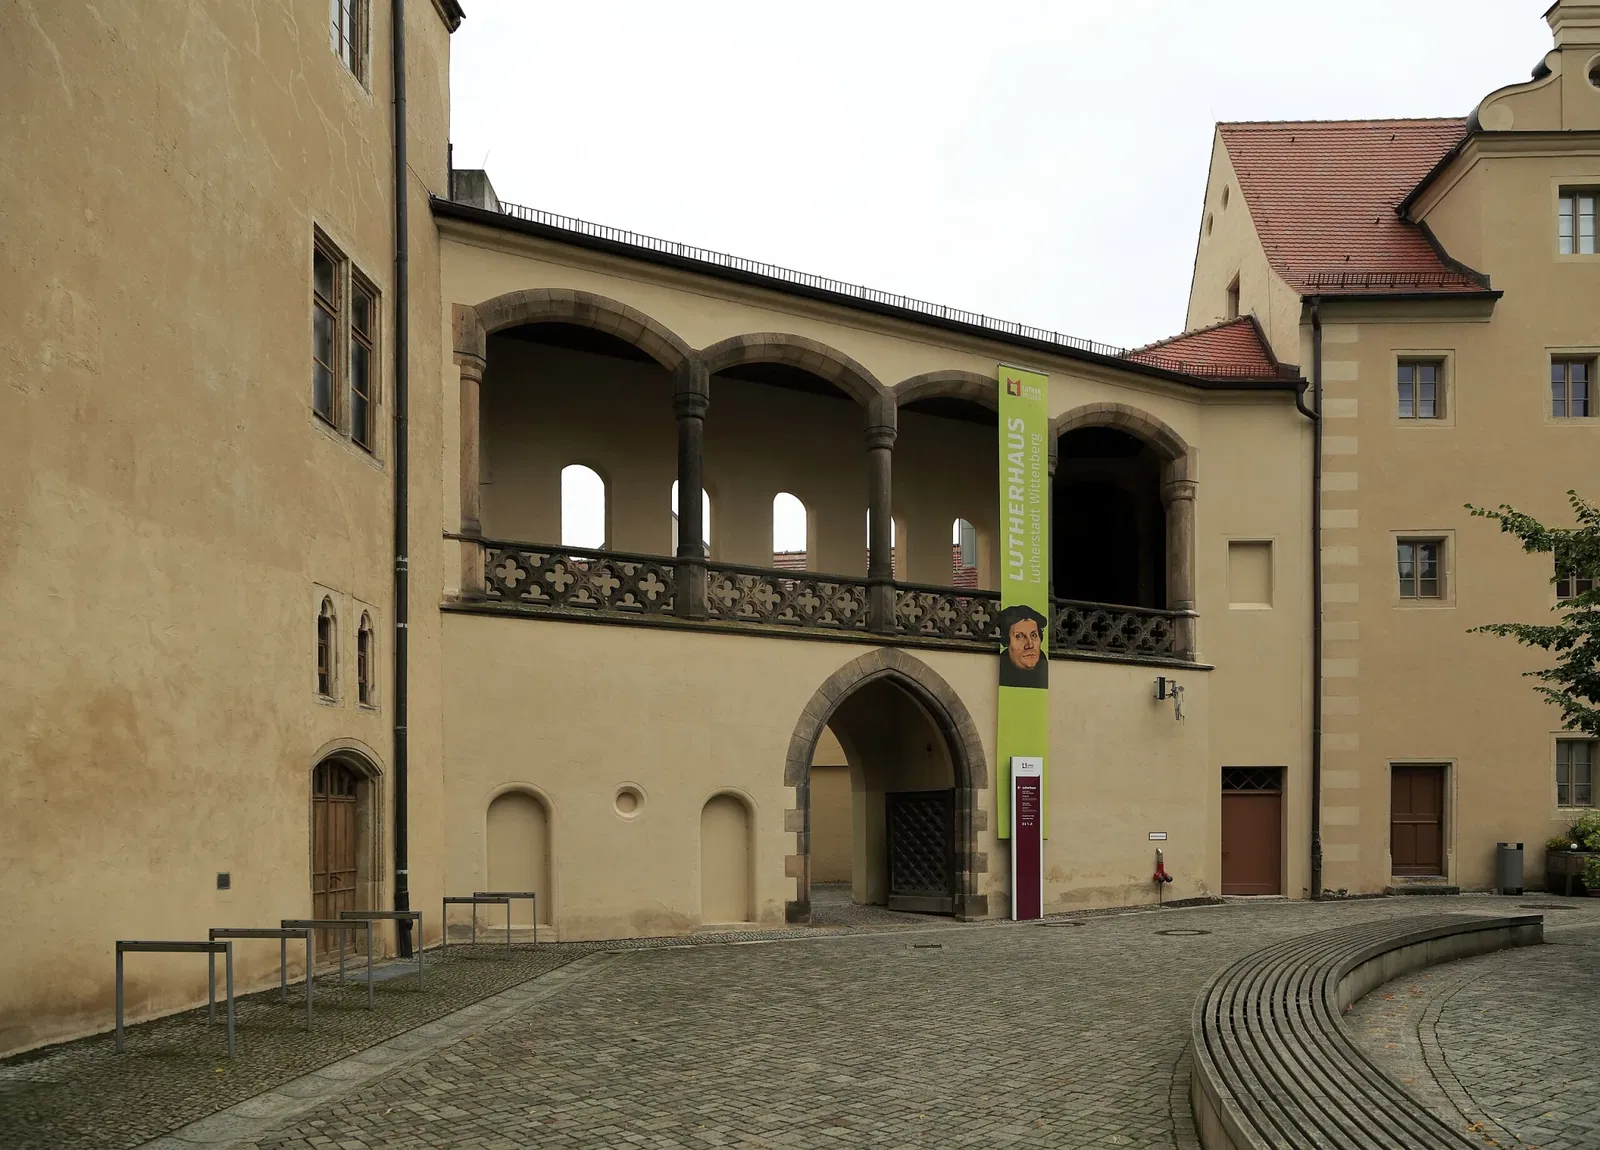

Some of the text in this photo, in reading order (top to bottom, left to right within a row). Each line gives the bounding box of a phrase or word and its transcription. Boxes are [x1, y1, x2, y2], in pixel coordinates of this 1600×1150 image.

[1007, 416, 1025, 581] LUTHERHAUS
[1028, 431, 1043, 584] Lutherstadt Wittenberg
